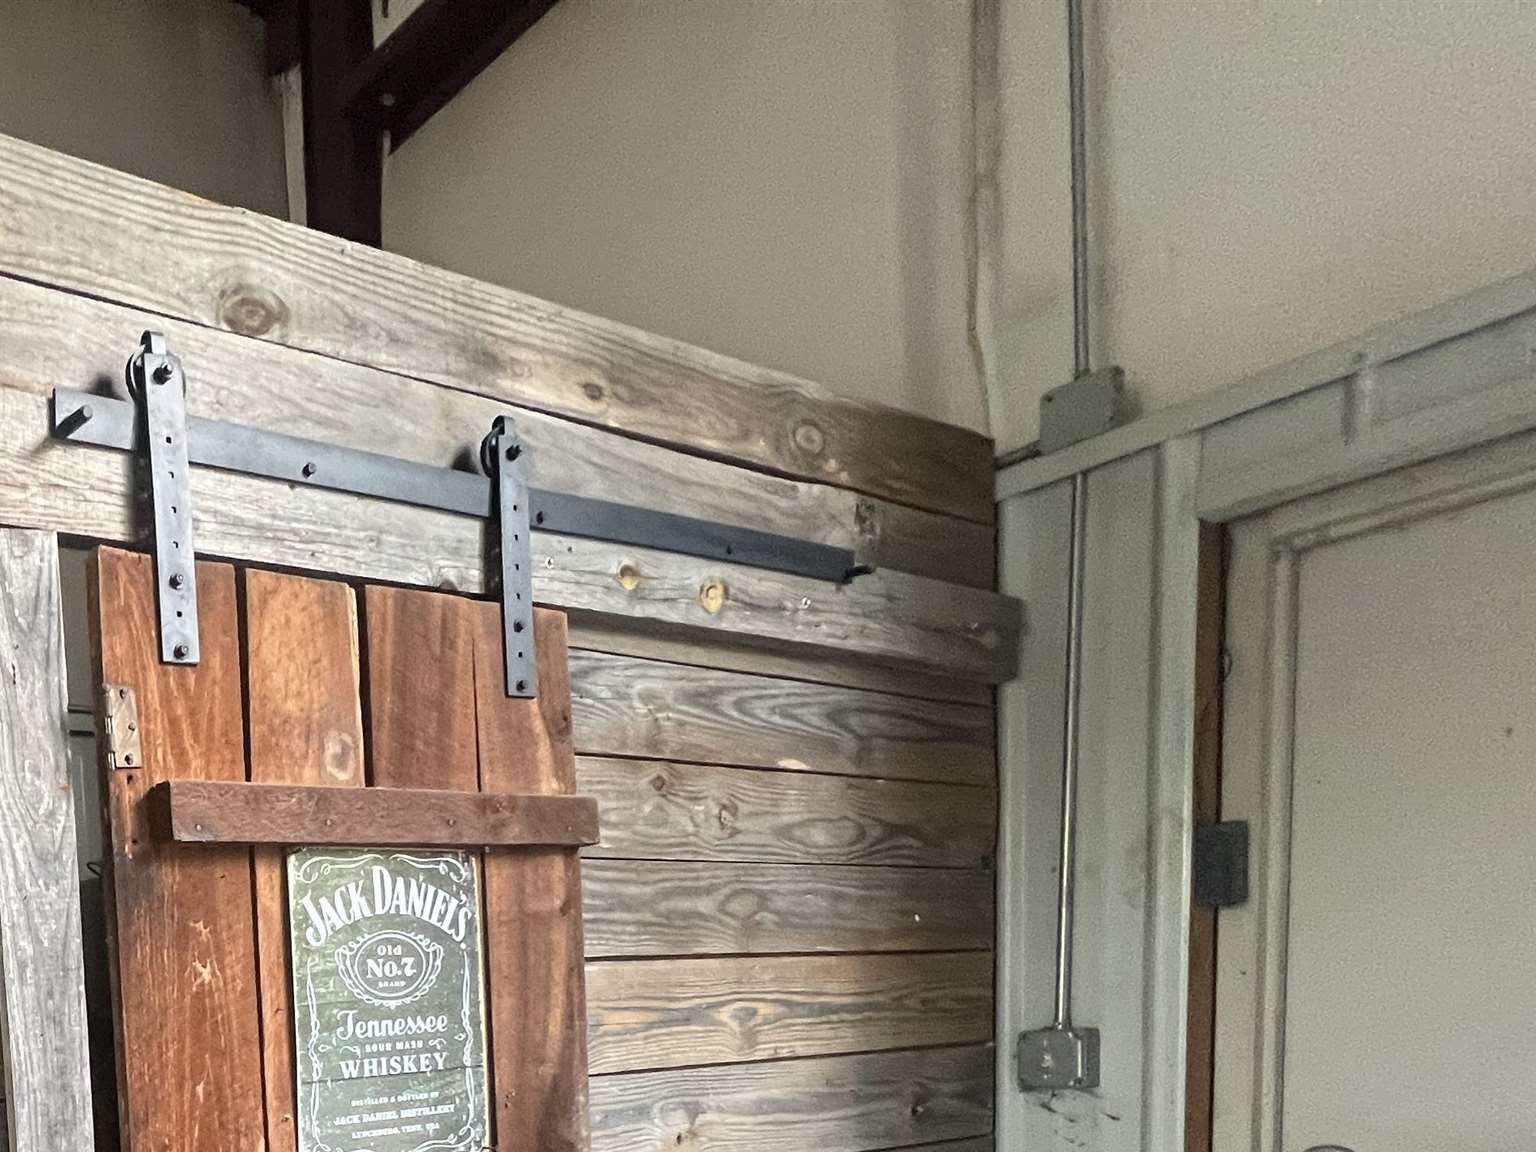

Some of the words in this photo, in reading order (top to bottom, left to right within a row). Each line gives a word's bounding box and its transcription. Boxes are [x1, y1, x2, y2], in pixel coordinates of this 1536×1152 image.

[300, 879, 373, 947] JACK
[336, 1010, 448, 1040] Tennessee
[365, 1042, 392, 1053] SOUR
[339, 1052, 449, 1079] WHISKEY
